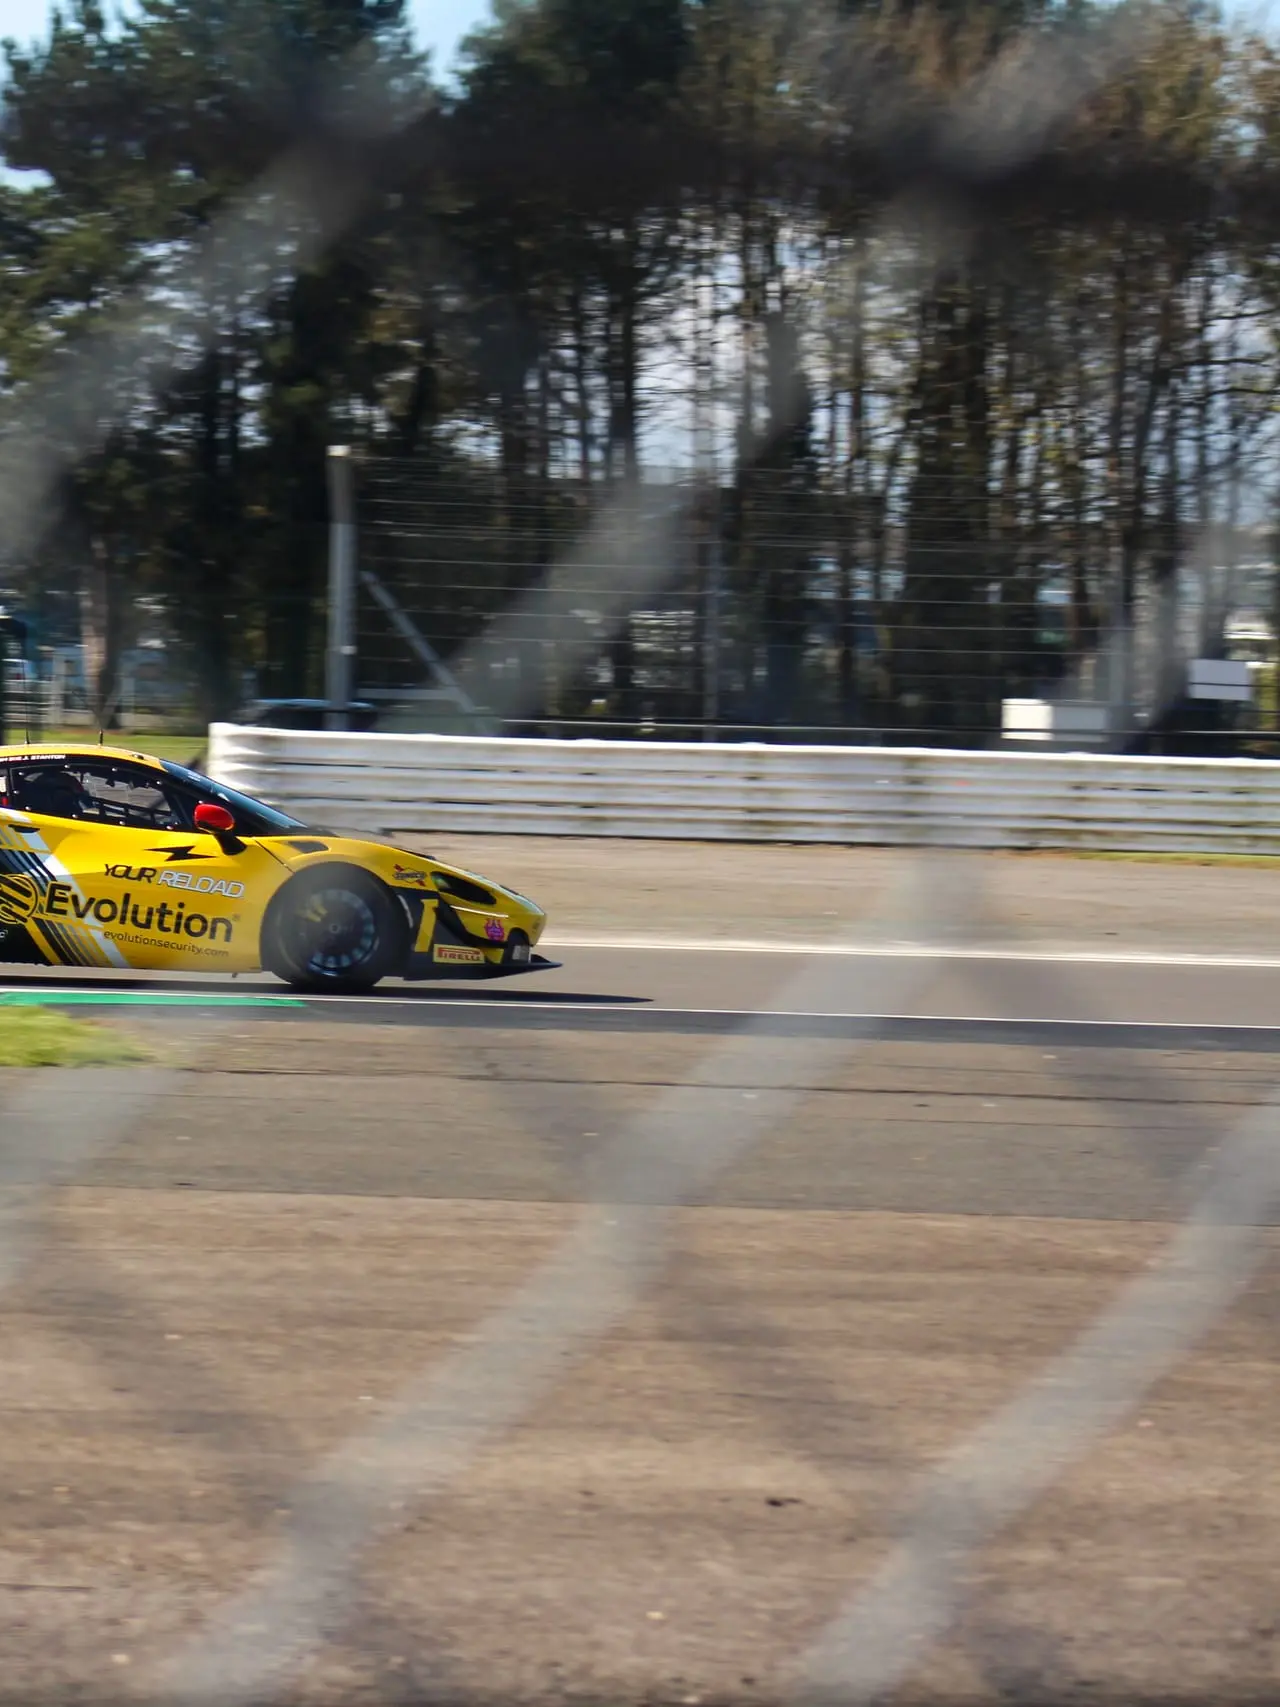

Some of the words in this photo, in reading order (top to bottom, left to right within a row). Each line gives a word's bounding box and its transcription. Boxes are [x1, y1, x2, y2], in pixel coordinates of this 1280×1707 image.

[104, 863, 157, 884] YOUR
[157, 870, 245, 898] RELOAD
[45, 883, 234, 943] Evolution
[103, 930, 230, 957] evolutionsecurity.com
[437, 947, 481, 961] PIRELLI
